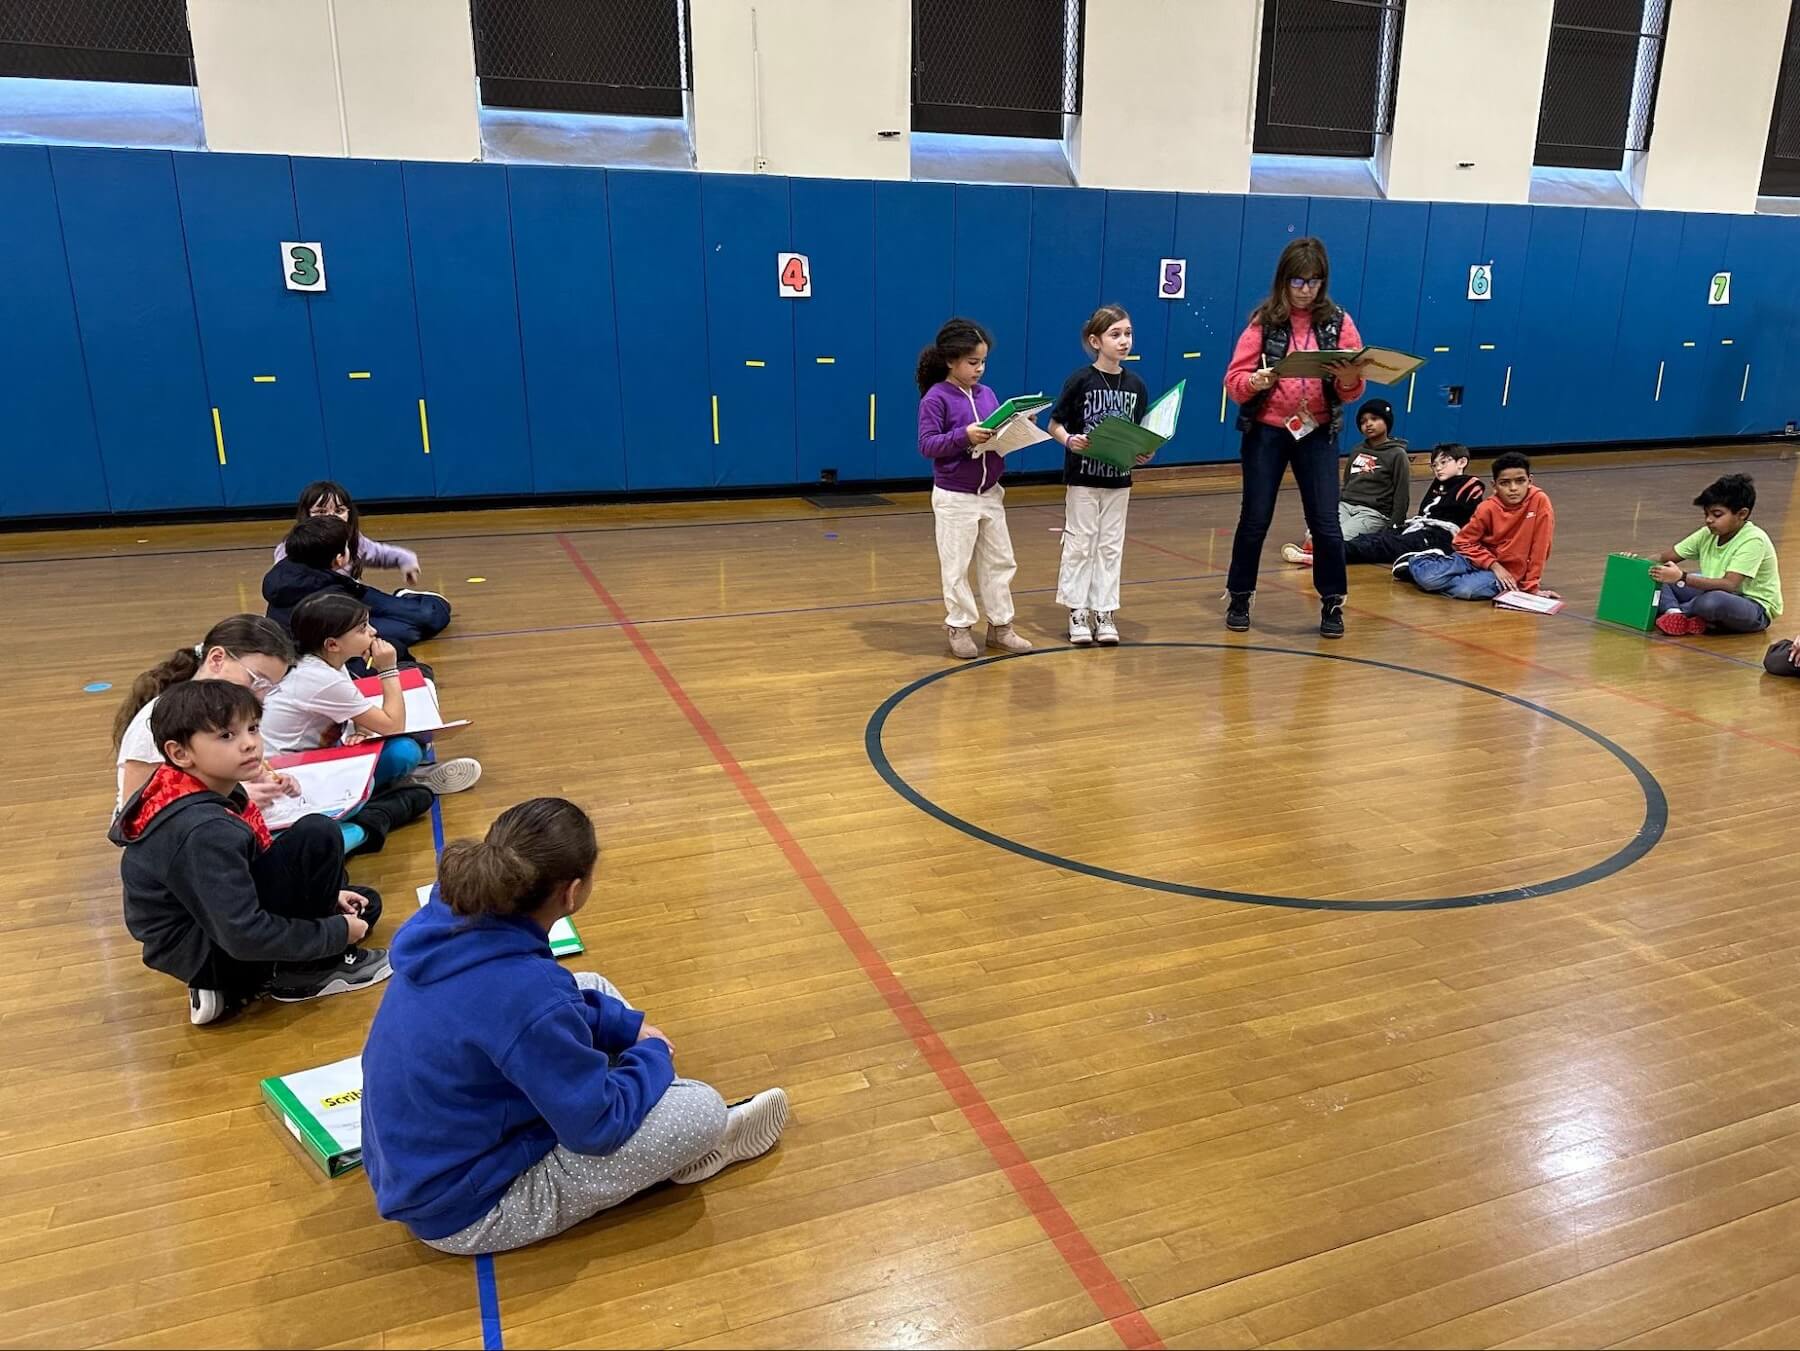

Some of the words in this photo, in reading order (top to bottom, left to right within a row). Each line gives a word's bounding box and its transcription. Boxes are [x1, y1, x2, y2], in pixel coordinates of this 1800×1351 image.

[291, 246, 319, 285] 3
[781, 258, 807, 292] 4
[1162, 264, 1181, 294] 5
[1472, 267, 1488, 295] 6
[1714, 275, 1726, 301] 7
[1083, 389, 1137, 423] SUMMER
[325, 1089, 363, 1107] Scrib
